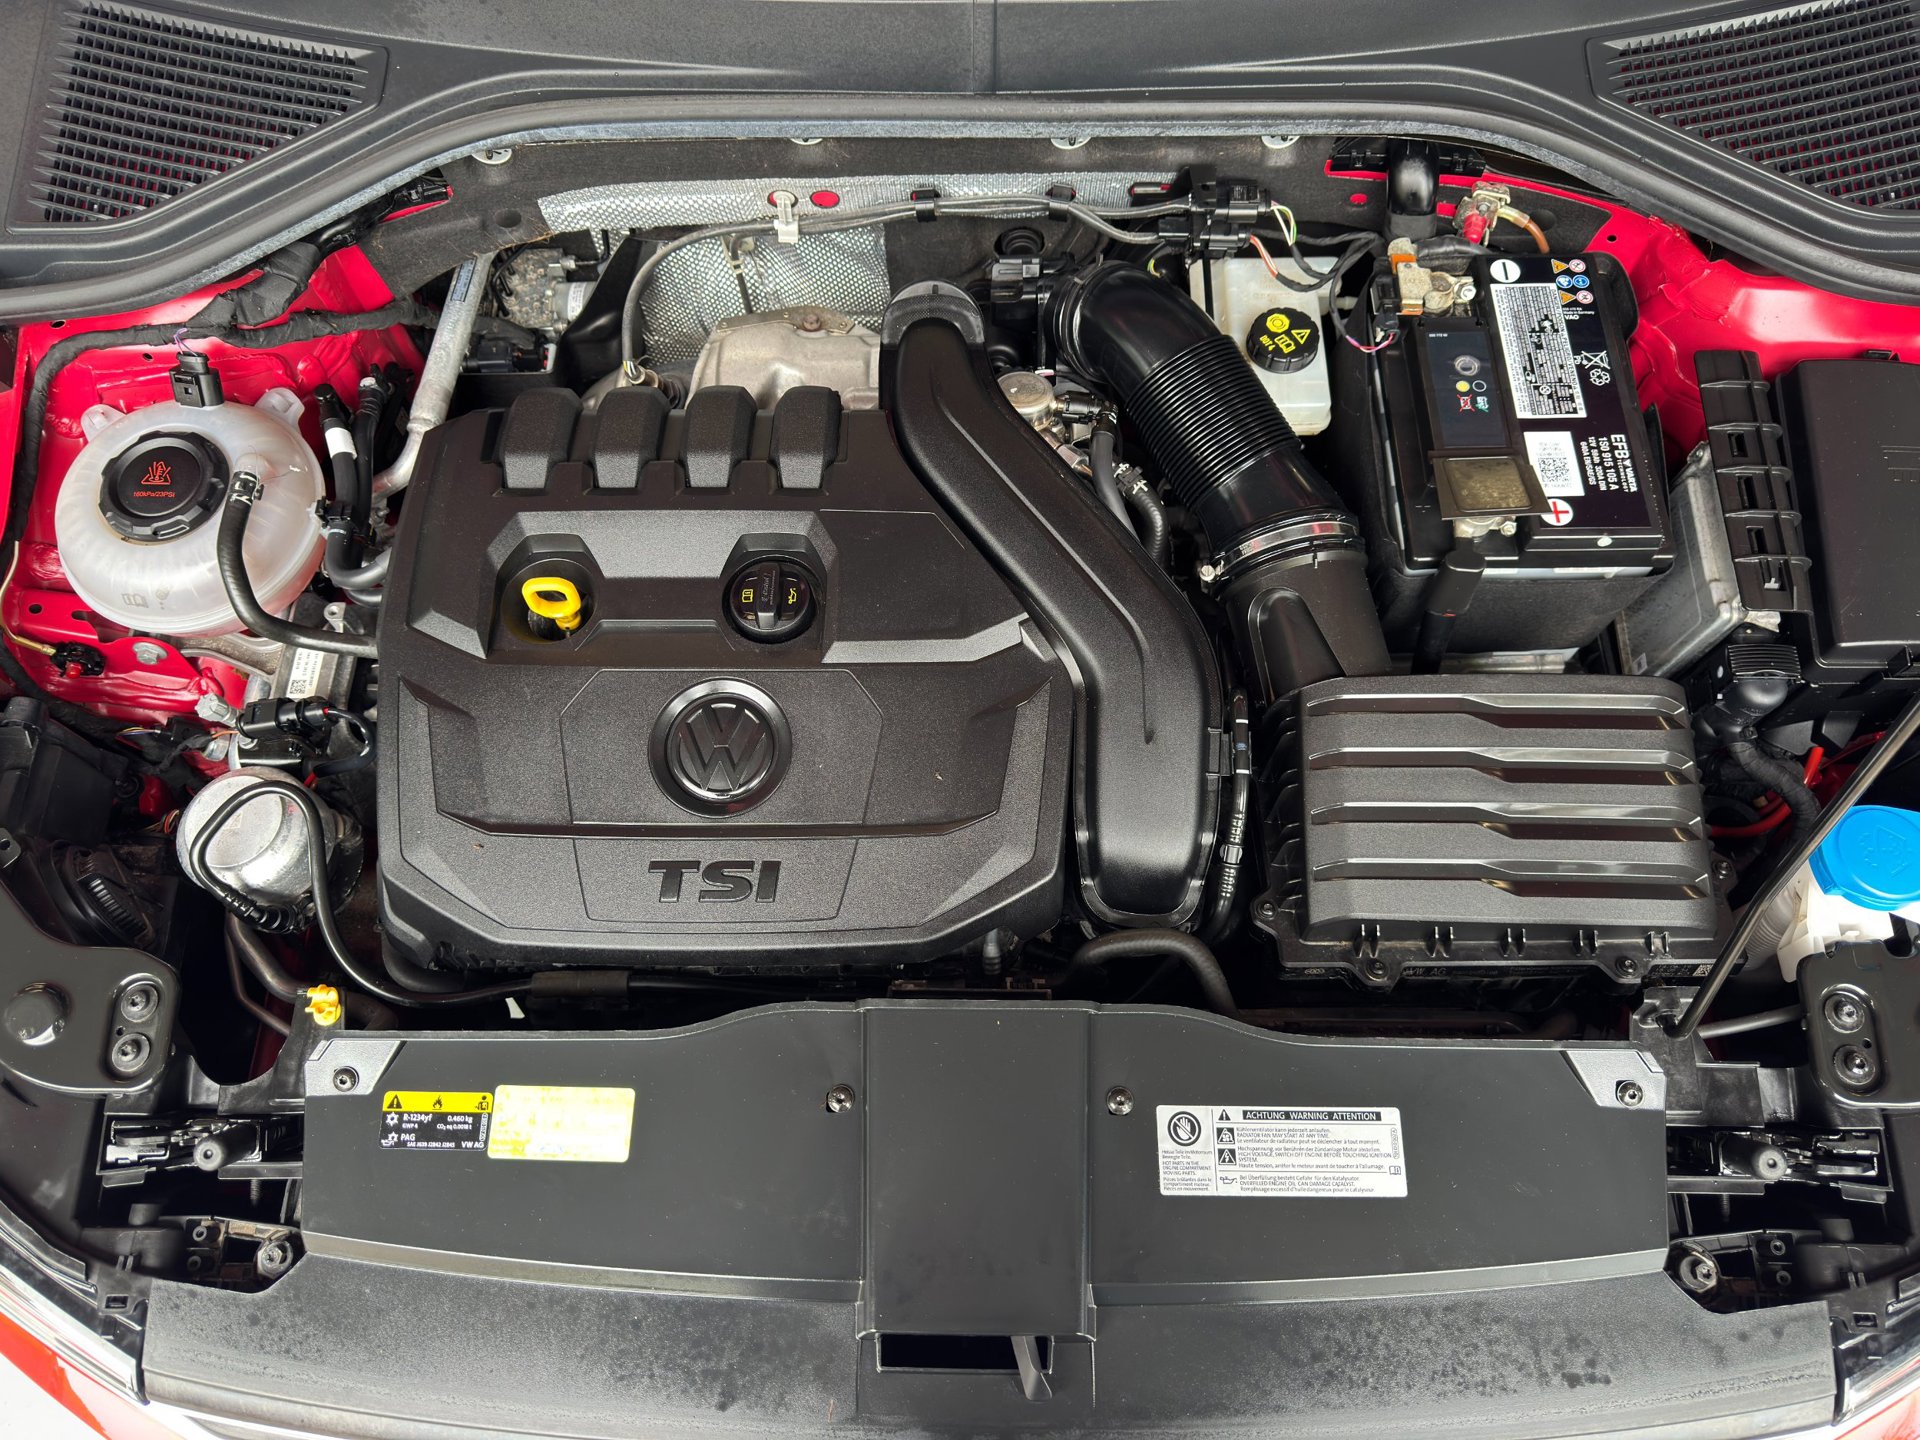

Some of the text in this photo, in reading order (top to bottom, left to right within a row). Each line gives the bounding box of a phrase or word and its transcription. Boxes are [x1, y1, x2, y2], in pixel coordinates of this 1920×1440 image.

[1574, 355, 1582, 364] Pb
[1610, 434, 1630, 458] EFB
[1588, 436, 1598, 448] 12V
[1599, 480, 1608, 491] DIN
[1602, 452, 1614, 467] 915
[1606, 468, 1617, 482] 105
[1616, 459, 1629, 492] TECHNOLOGY
[1625, 468, 1638, 492] VARTA
[648, 860, 782, 902] TSI
[402, 1113, 432, 1123] R-1234yf
[465, 1115, 473, 1123] kg
[1246, 1112, 1376, 1120] ACHTUNG WARNING ATTENTION
